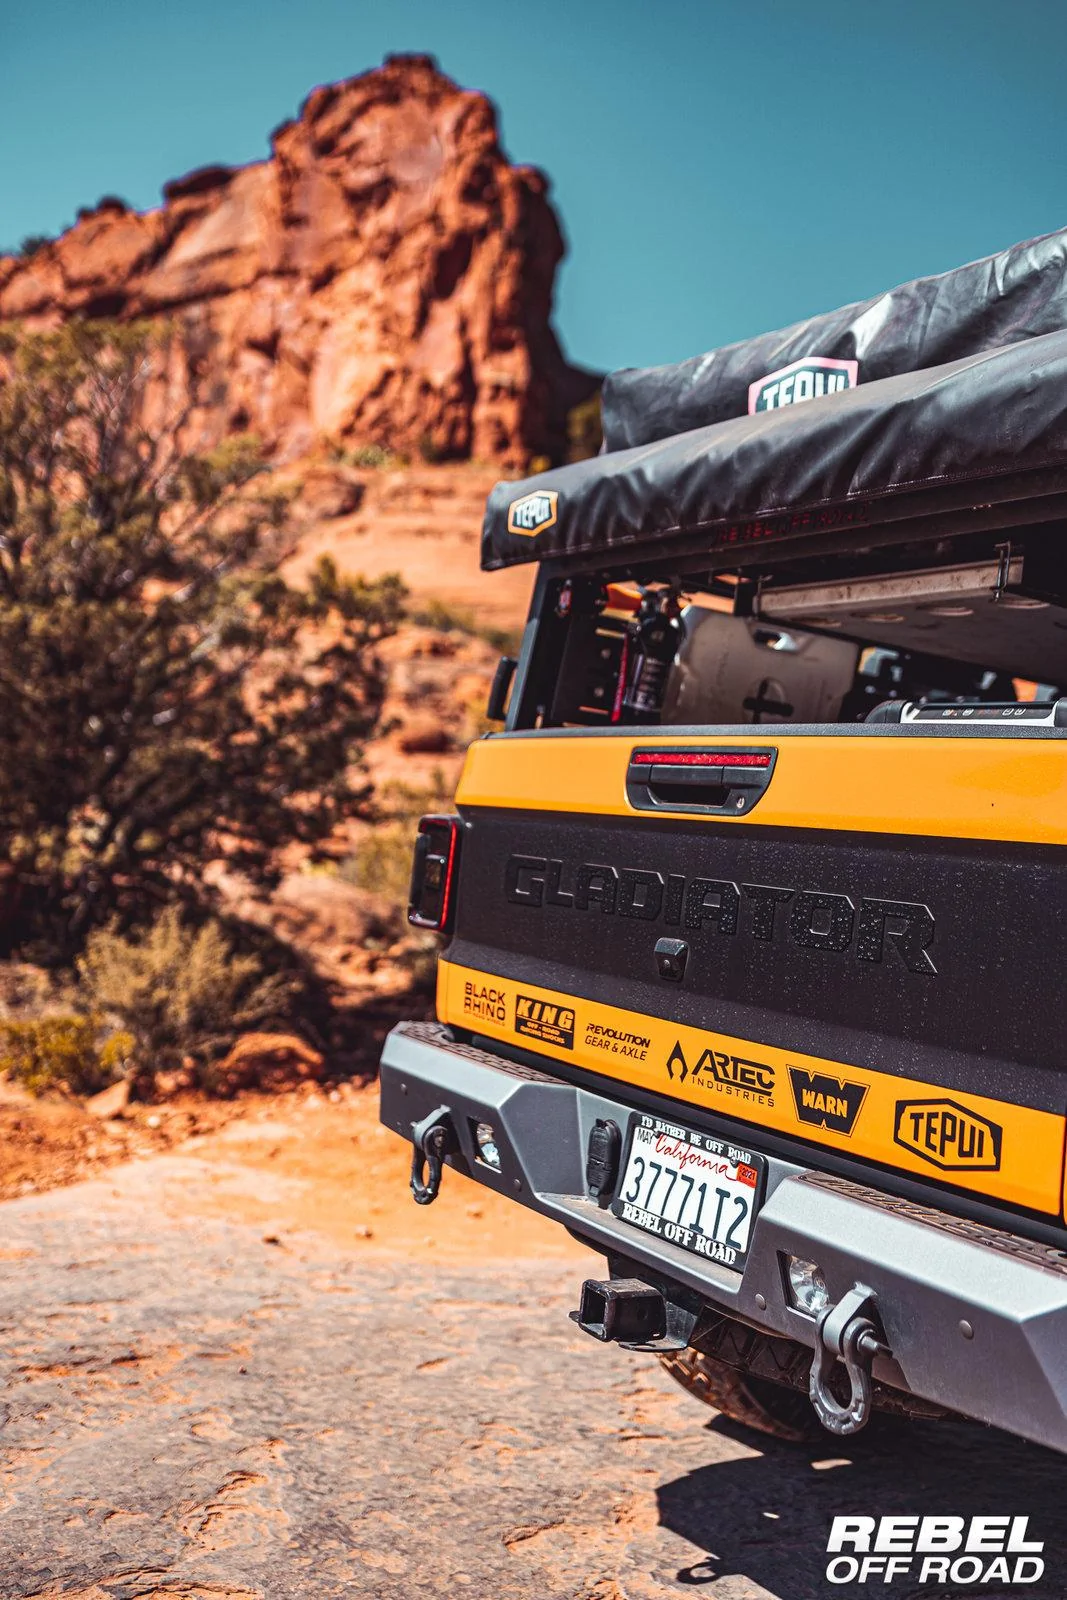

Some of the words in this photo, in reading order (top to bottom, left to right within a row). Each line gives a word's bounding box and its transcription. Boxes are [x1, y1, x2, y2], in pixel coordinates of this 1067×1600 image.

[515, 496, 550, 528] TEPUI
[505, 854, 938, 976] GLADIATOR
[464, 997, 506, 1021] RHINO
[465, 982, 506, 1006] BLACK
[516, 998, 574, 1029] KING
[585, 1036, 610, 1051] GEAR
[611, 1043, 618, 1053] &
[620, 1046, 647, 1061] AXLE
[586, 1023, 651, 1048] REVOLUTION
[691, 1049, 776, 1096] ARTEC
[692, 1076, 775, 1107] INDUSTRIES
[802, 1089, 848, 1118] WARN
[641, 1116, 653, 1127] I'D
[655, 1121, 686, 1141] RATHER
[690, 1133, 702, 1146] BE
[706, 1140, 724, 1154] OFF
[728, 1147, 751, 1165] ROAD
[910, 1112, 985, 1158] TEPUI
[636, 1128, 653, 1145] MAY
[655, 1133, 738, 1182] California
[626, 1157, 748, 1249] 37771T2
[622, 1203, 662, 1233] REBEL
[664, 1217, 694, 1246] OFF
[695, 1232, 737, 1265] ROAD
